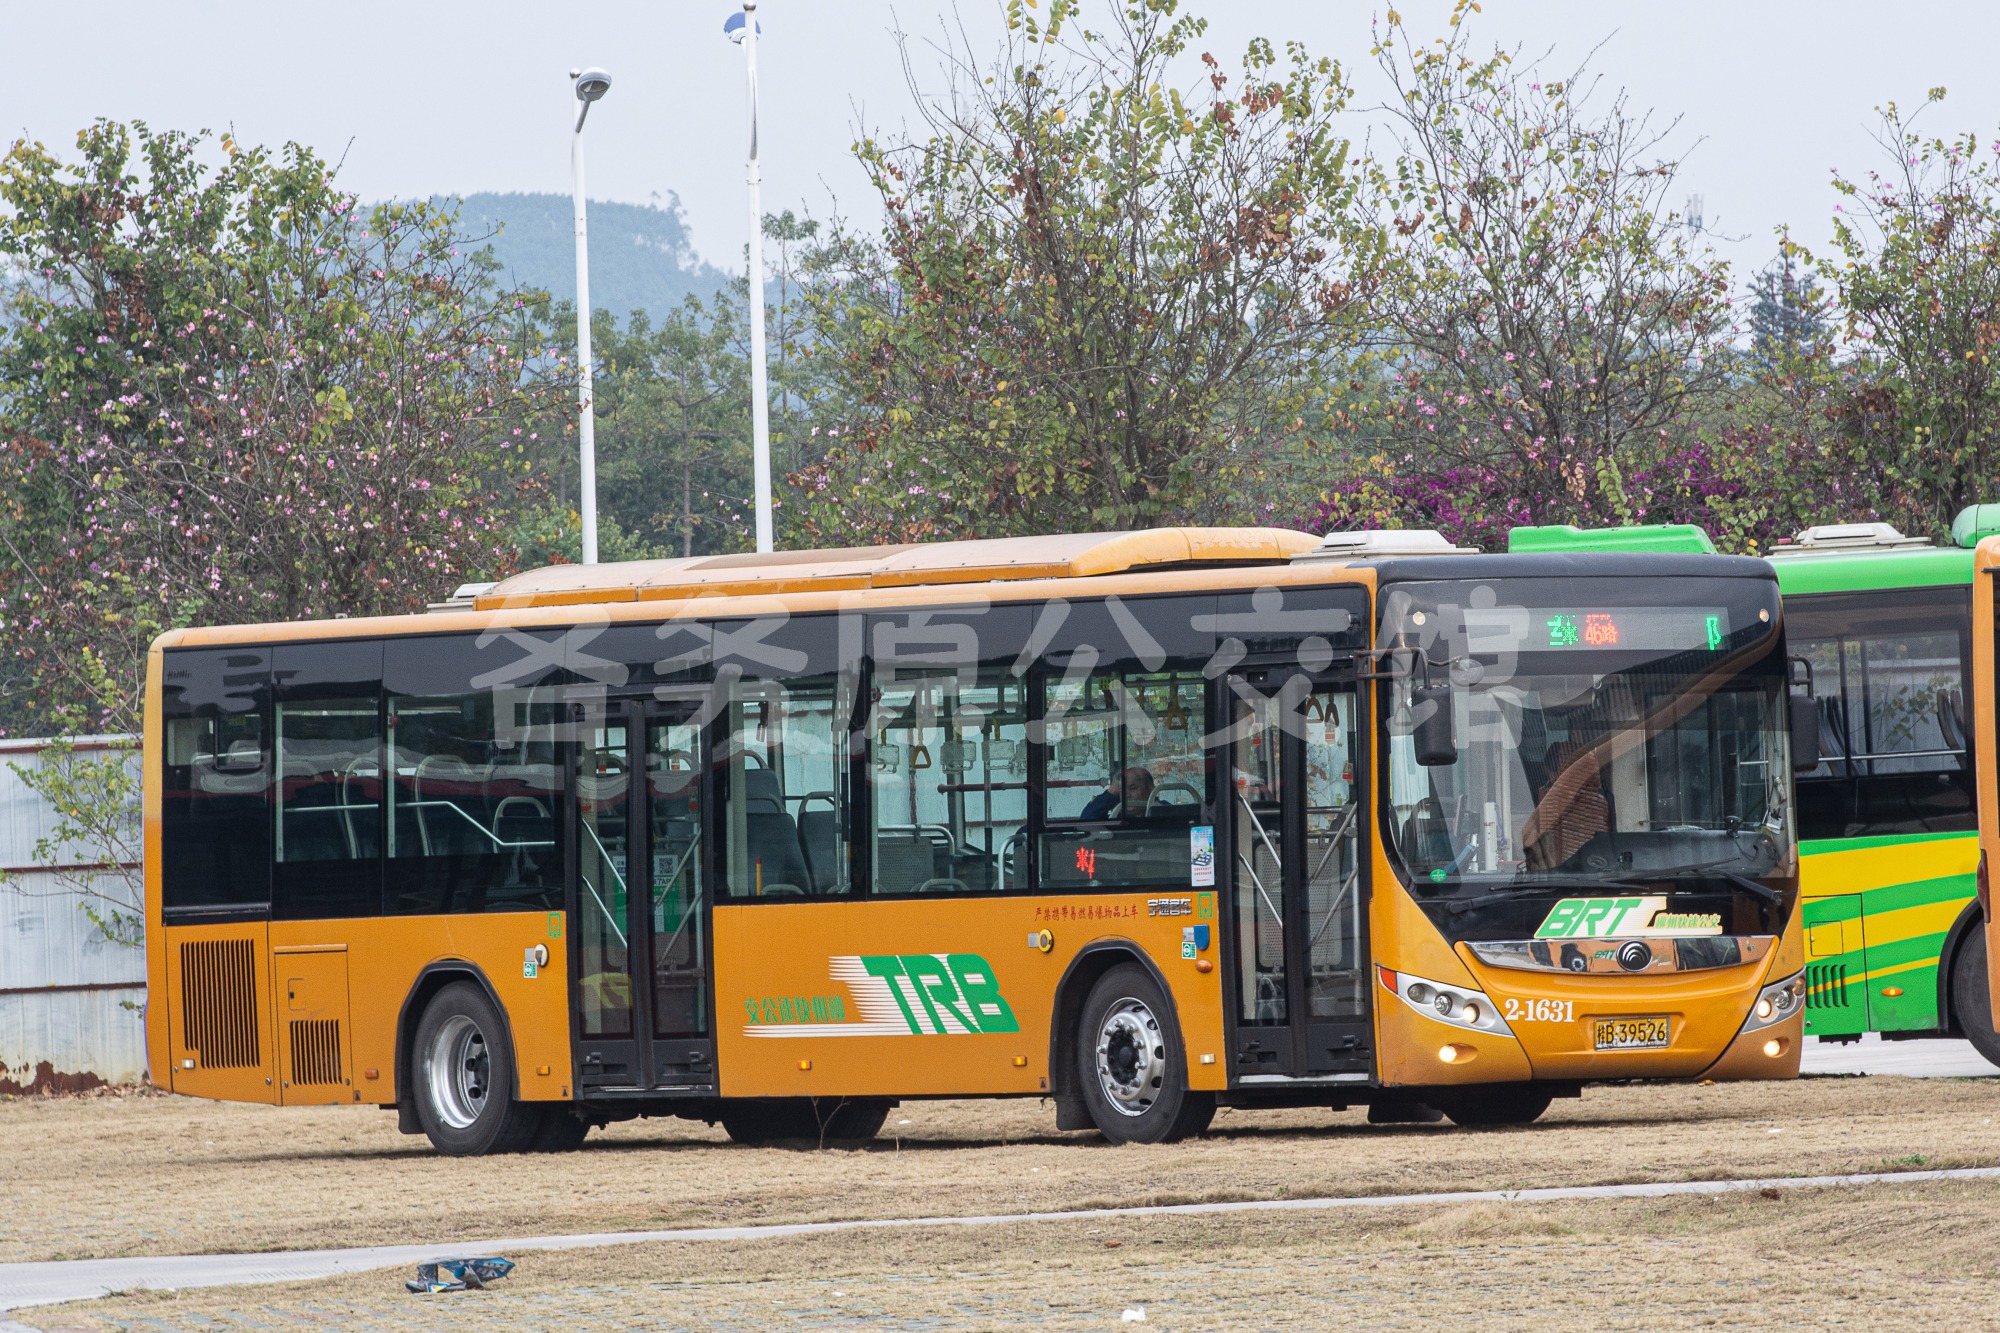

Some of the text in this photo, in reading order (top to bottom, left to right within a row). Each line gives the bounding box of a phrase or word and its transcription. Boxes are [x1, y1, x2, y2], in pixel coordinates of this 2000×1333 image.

[1147, 897, 1192, 917] 宇通客车
[1536, 898, 1642, 937] BRT
[1505, 998, 1575, 1023] 2-1631
